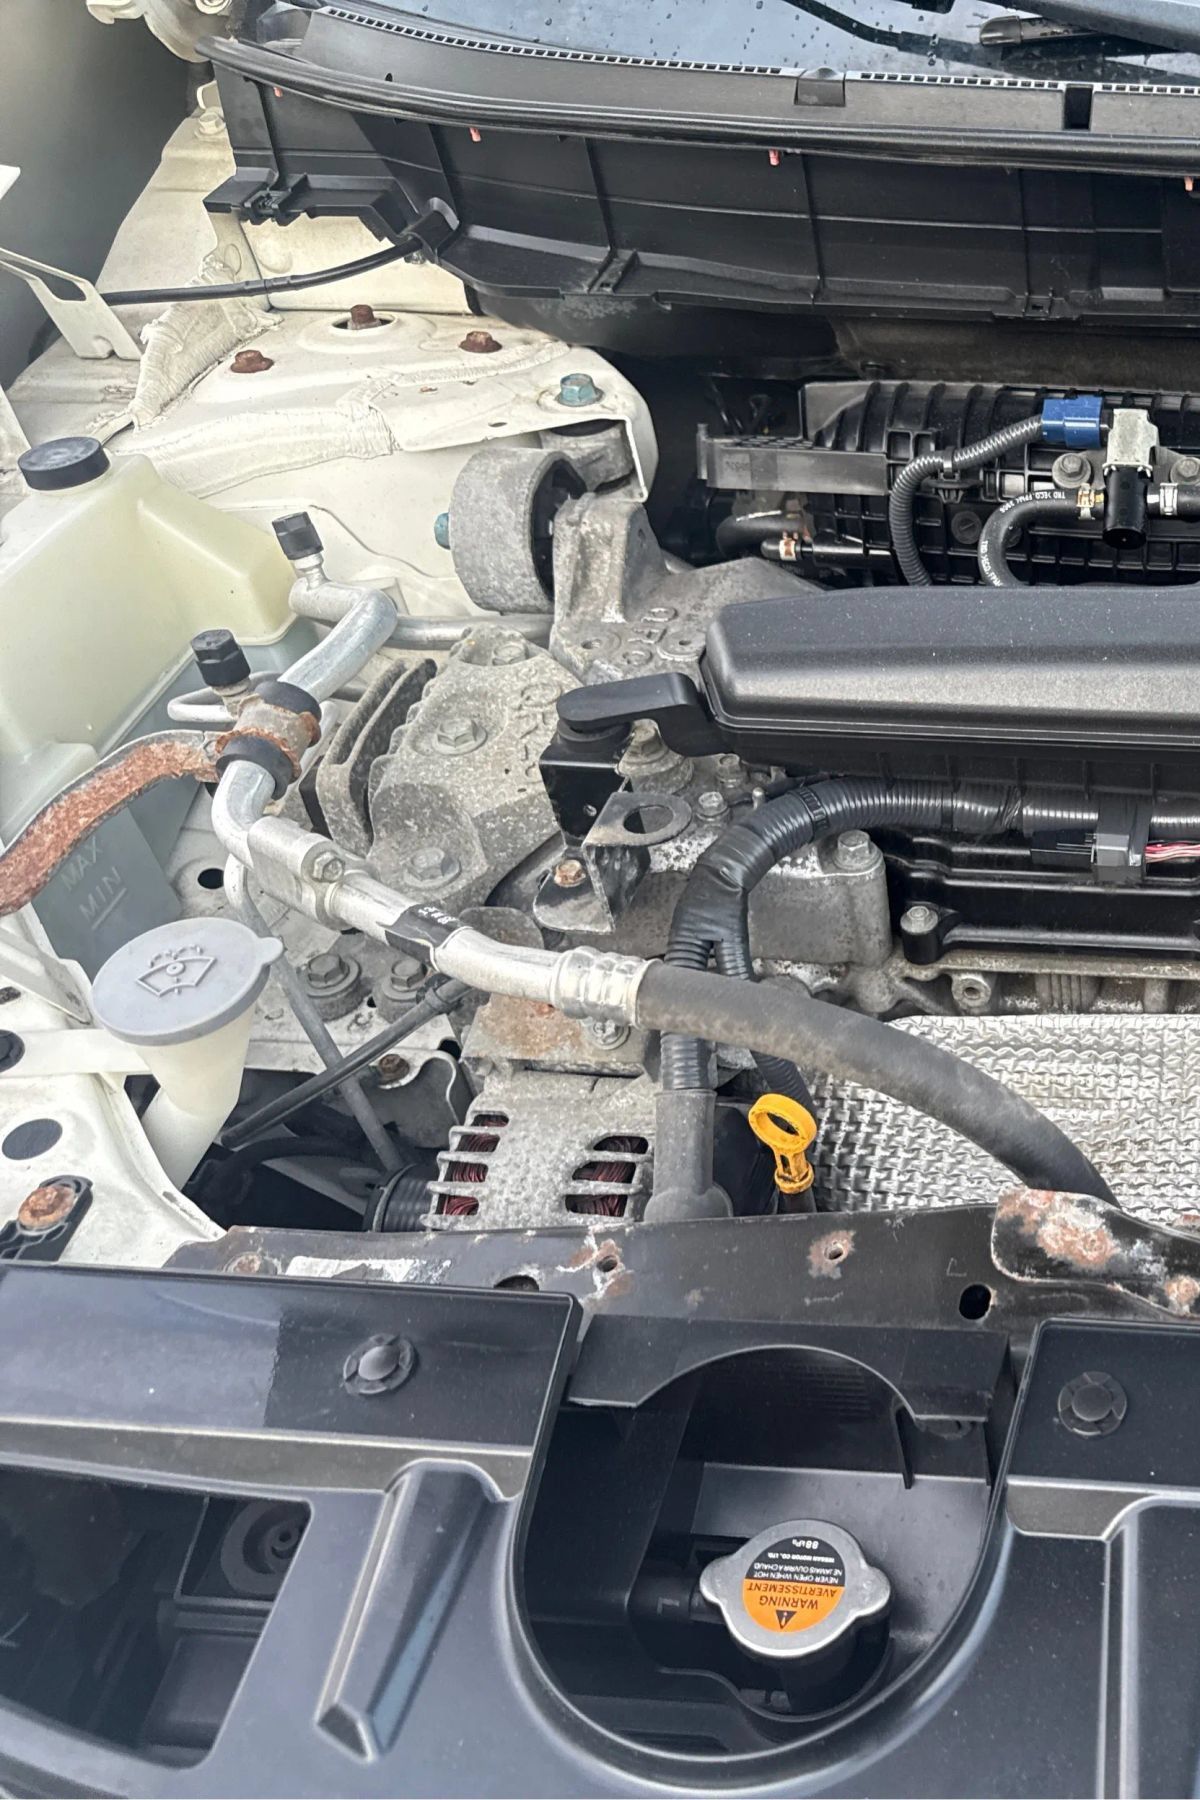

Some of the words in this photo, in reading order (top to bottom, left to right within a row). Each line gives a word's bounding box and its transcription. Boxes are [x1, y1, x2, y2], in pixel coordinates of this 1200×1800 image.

[60, 835, 104, 892] MAX
[79, 865, 122, 922] MIN
[753, 1562, 779, 1571] CHAUD
[793, 1573, 814, 1581] OPEN
[814, 1575, 839, 1584] NEVER
[746, 1582, 838, 1598] AVERTISSEMENT
[758, 1594, 819, 1611] WARNING
